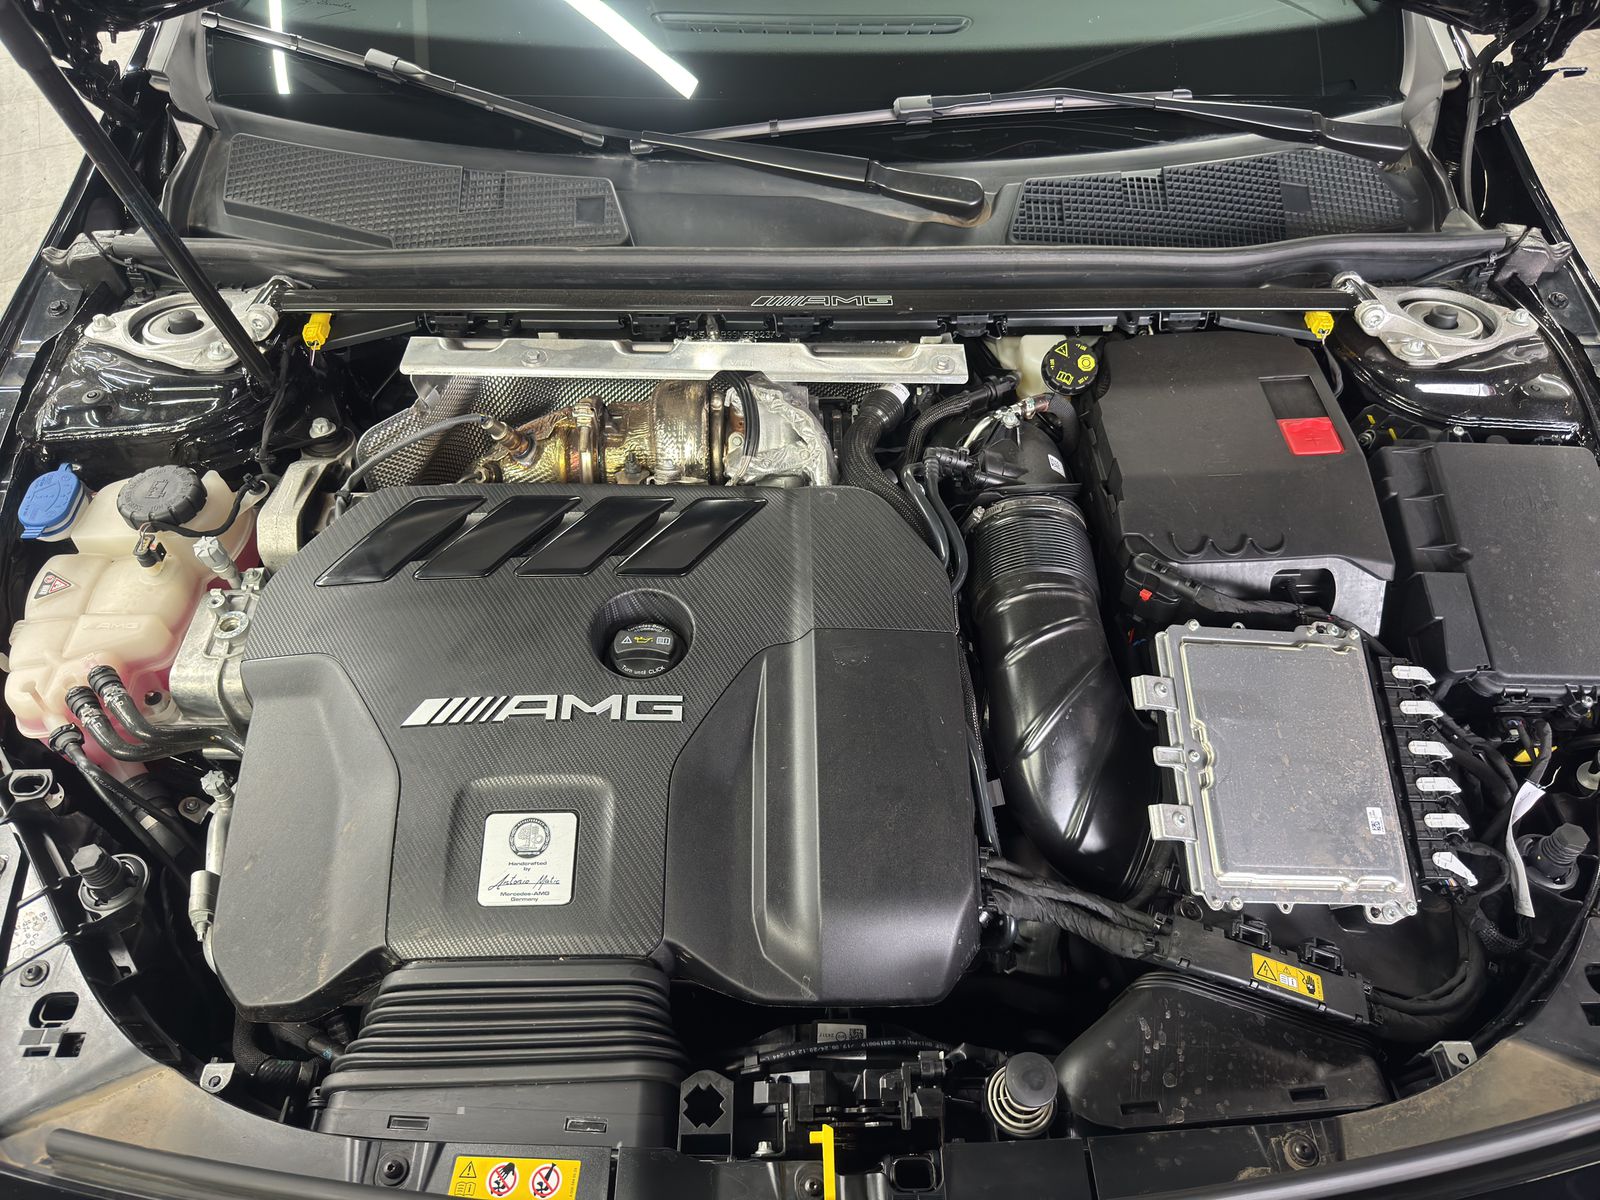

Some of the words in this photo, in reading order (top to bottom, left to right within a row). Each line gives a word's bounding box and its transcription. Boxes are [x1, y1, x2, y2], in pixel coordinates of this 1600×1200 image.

[798, 295, 893, 307] AMG
[621, 664, 633, 673] Turn
[648, 665, 666, 675] CLICK
[492, 694, 684, 722] AMG
